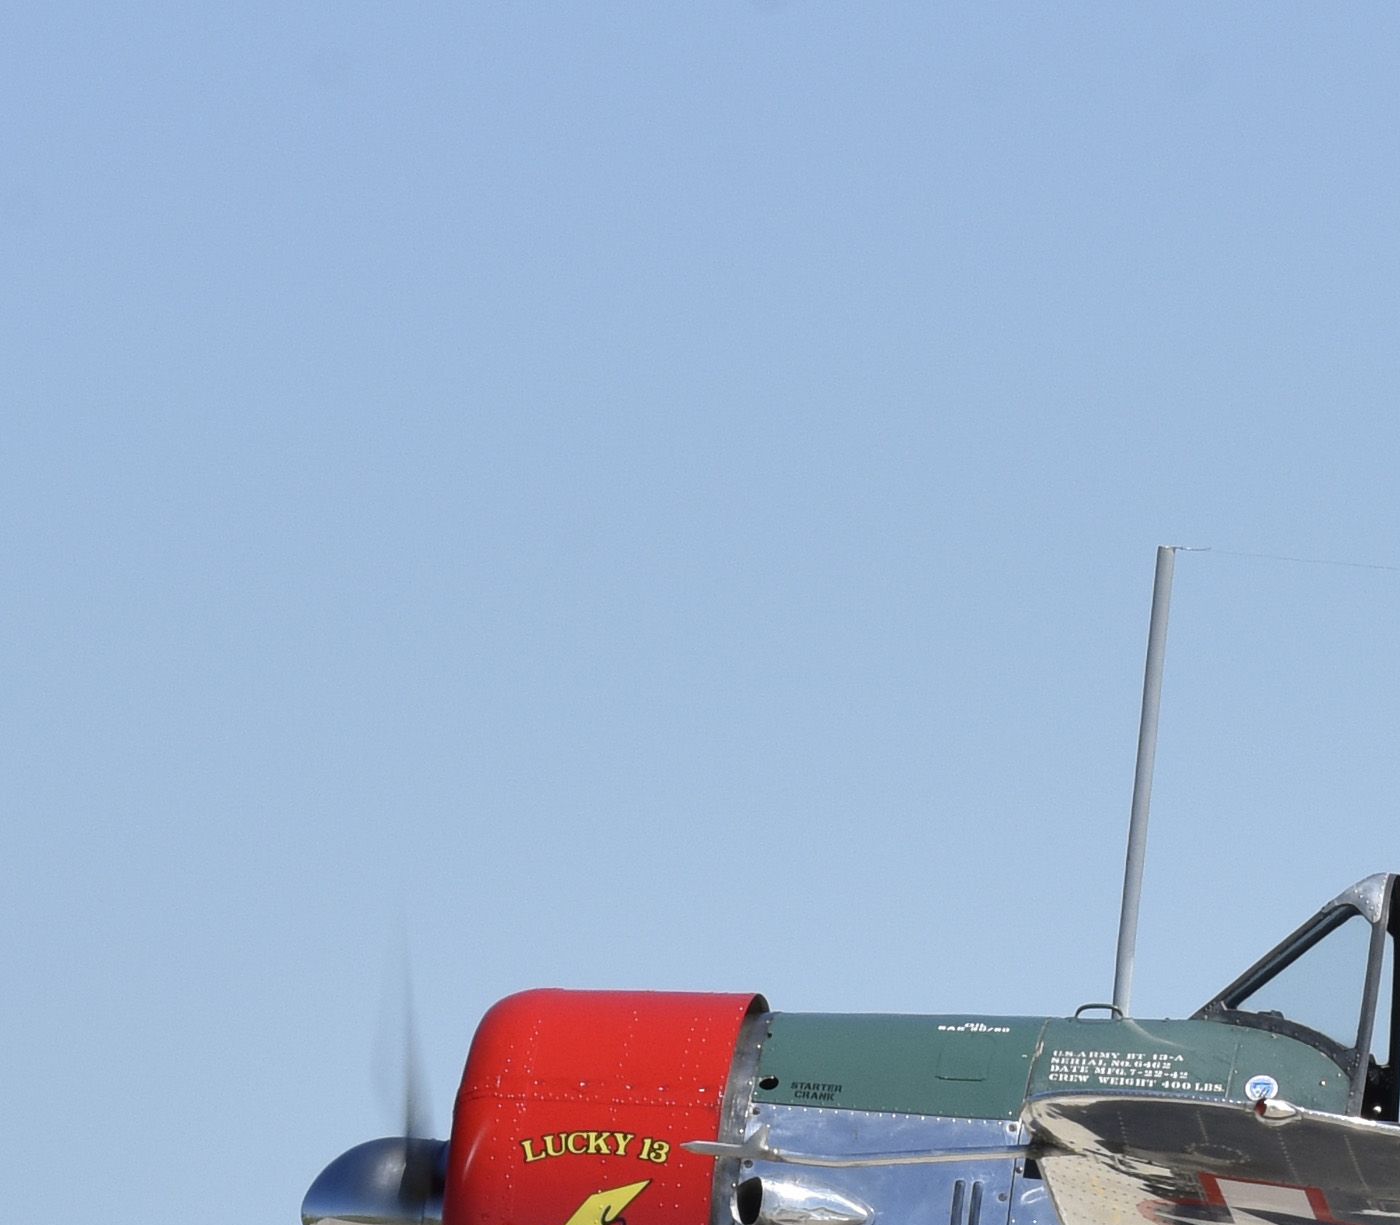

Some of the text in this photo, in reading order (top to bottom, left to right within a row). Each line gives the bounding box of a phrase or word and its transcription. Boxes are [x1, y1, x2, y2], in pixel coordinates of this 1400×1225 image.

[1051, 1058, 1107, 1067] SERIAL
[1126, 1053, 1146, 1061] BT
[1050, 1065, 1088, 1074] DATE
[790, 1081, 842, 1093] STARTER
[1048, 1073, 1090, 1083] CREW
[1098, 1076, 1157, 1088] WEIGHT
[1161, 1081, 1191, 1091] 400
[794, 1090, 834, 1101] CRANK
[521, 1131, 671, 1163] LUCKY 13
